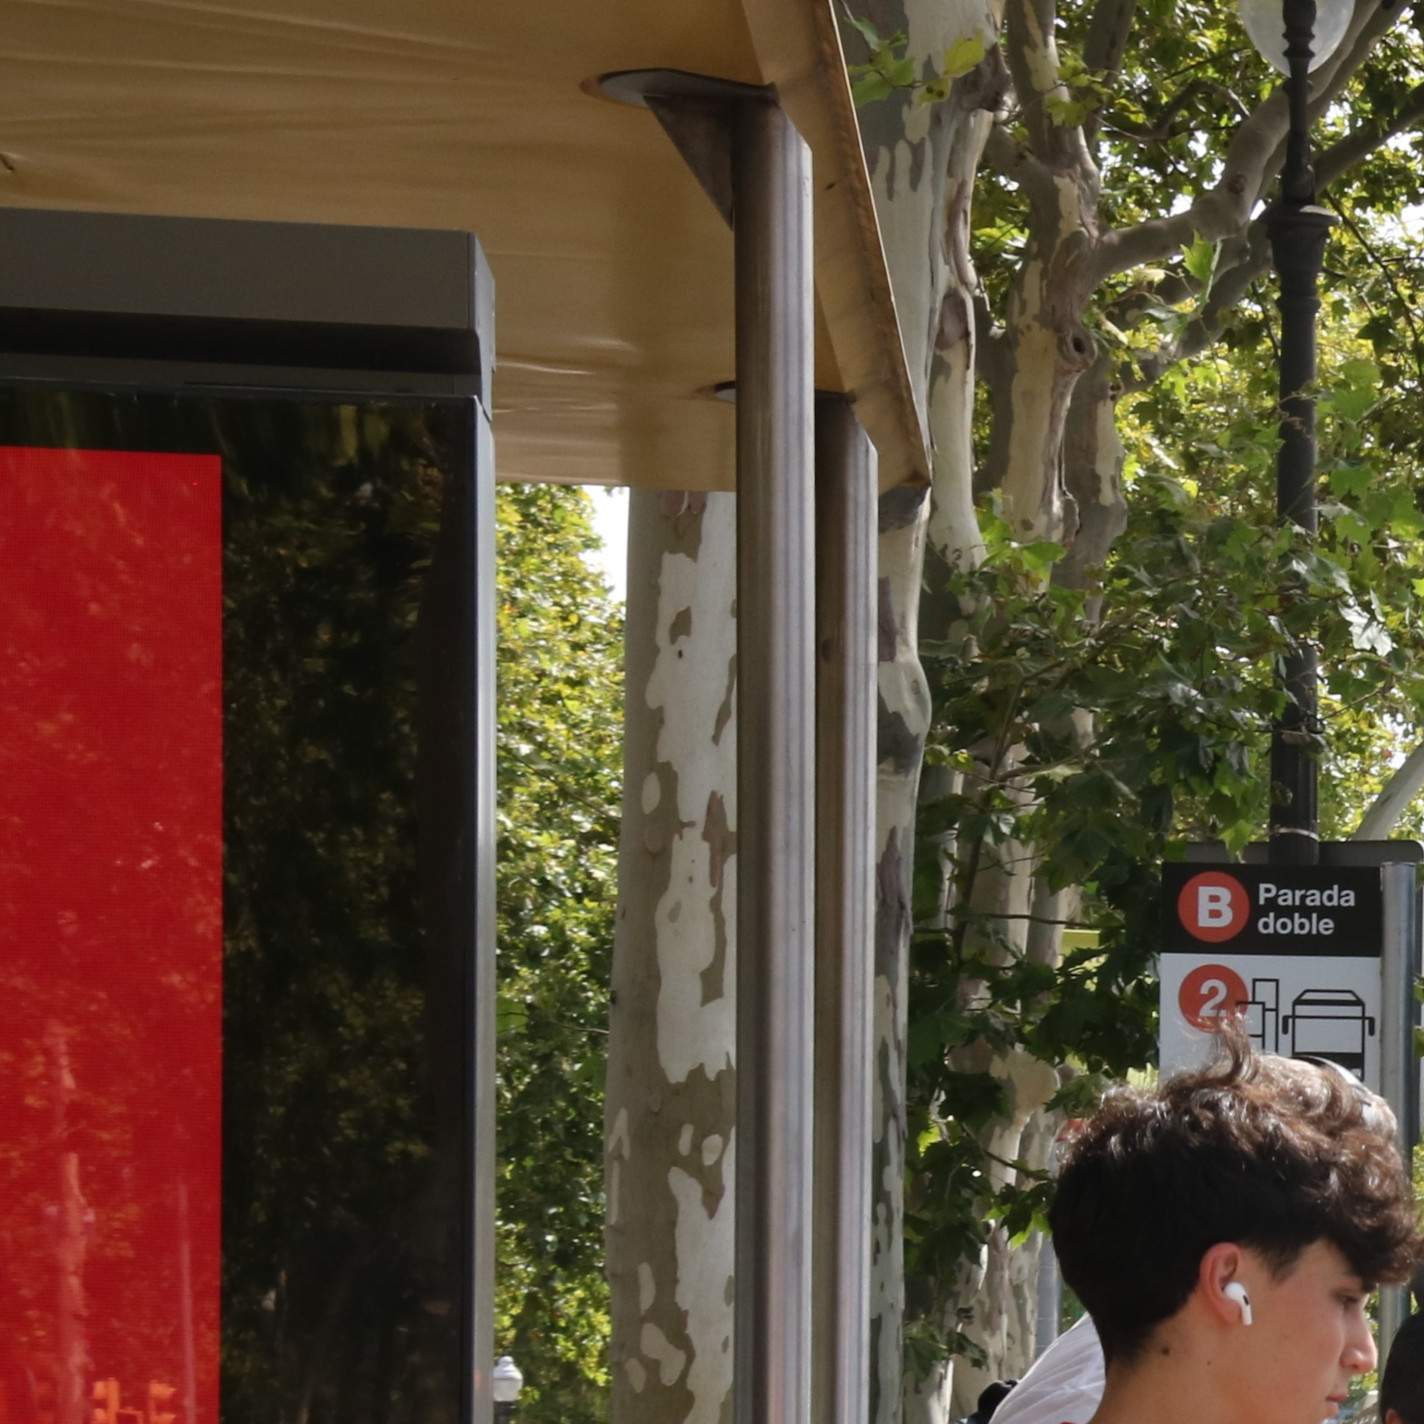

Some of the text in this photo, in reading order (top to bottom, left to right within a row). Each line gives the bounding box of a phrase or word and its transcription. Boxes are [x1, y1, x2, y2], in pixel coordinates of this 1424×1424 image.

[1197, 886, 1233, 928] B
[1258, 883, 1356, 906] Parada
[1257, 912, 1335, 935] doble
[1198, 979, 1228, 1017] 2
